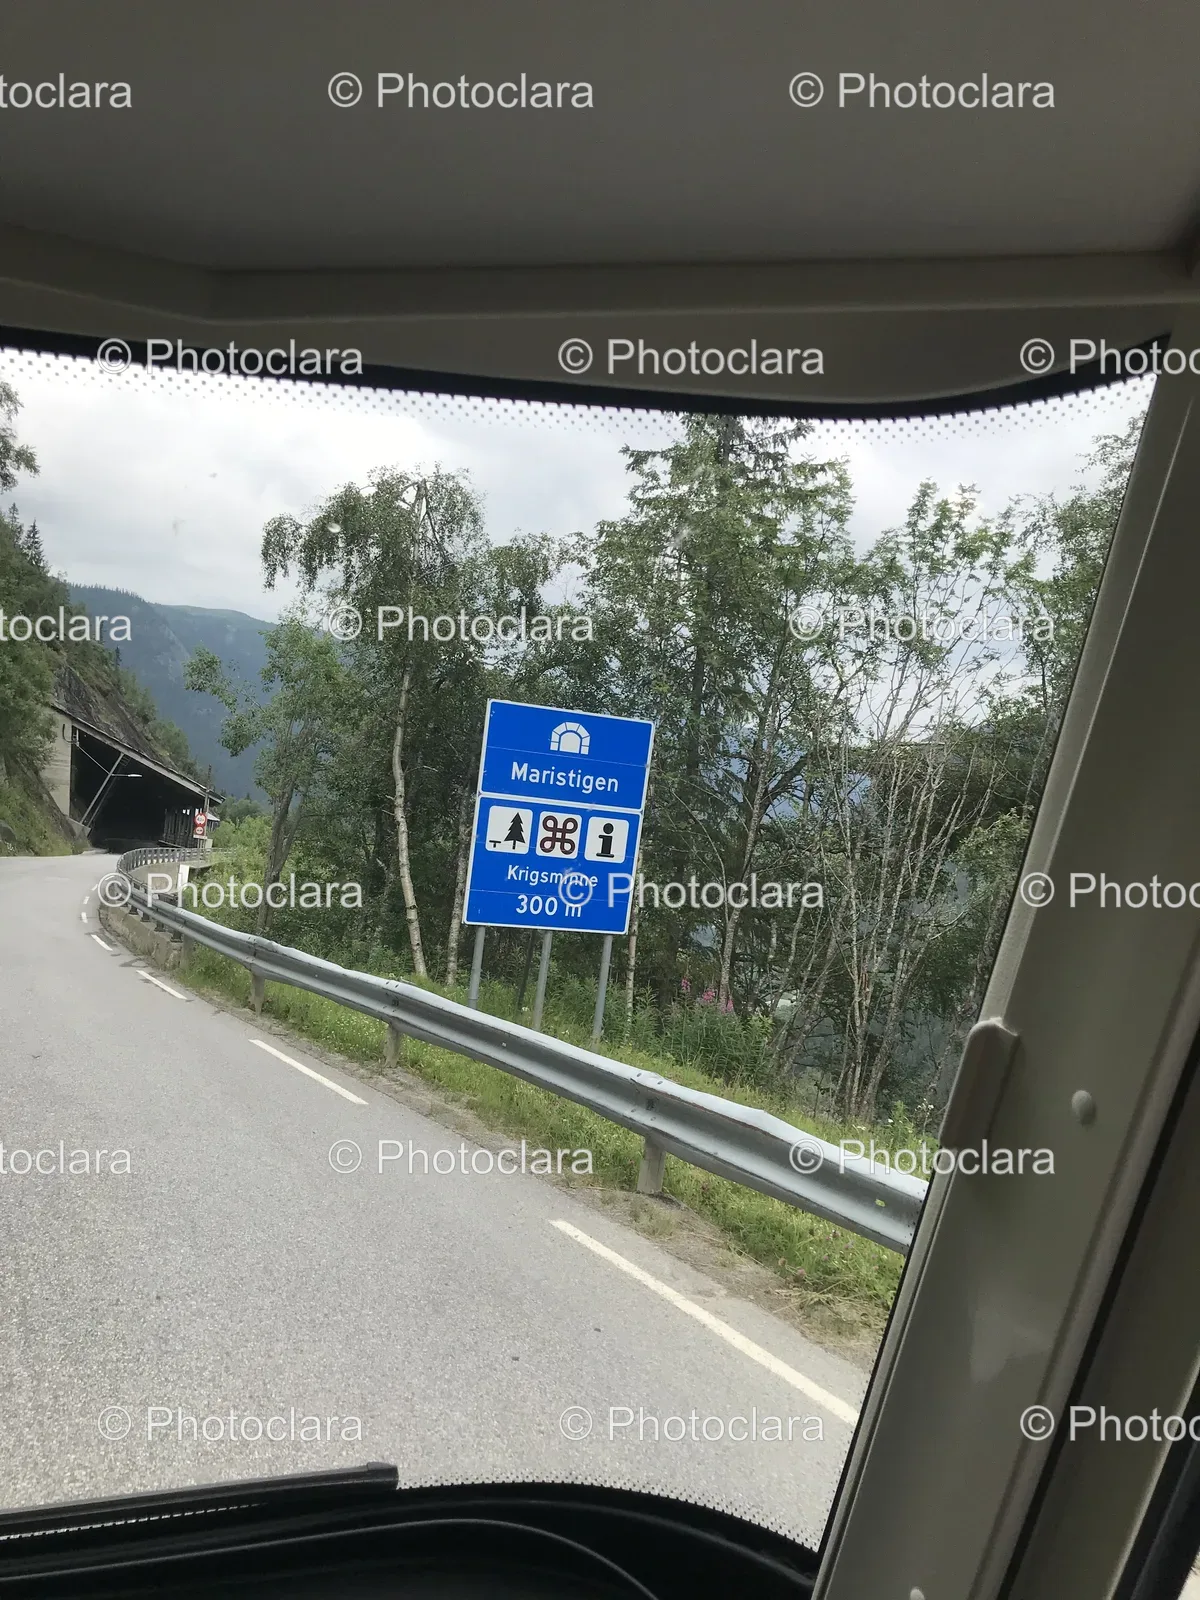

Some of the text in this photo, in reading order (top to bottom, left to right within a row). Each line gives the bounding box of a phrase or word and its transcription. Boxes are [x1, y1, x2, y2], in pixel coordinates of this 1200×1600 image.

[511, 762, 619, 793] Maristigen
[507, 865, 598, 887] Krigsminne
[515, 895, 581, 917] 300 m
